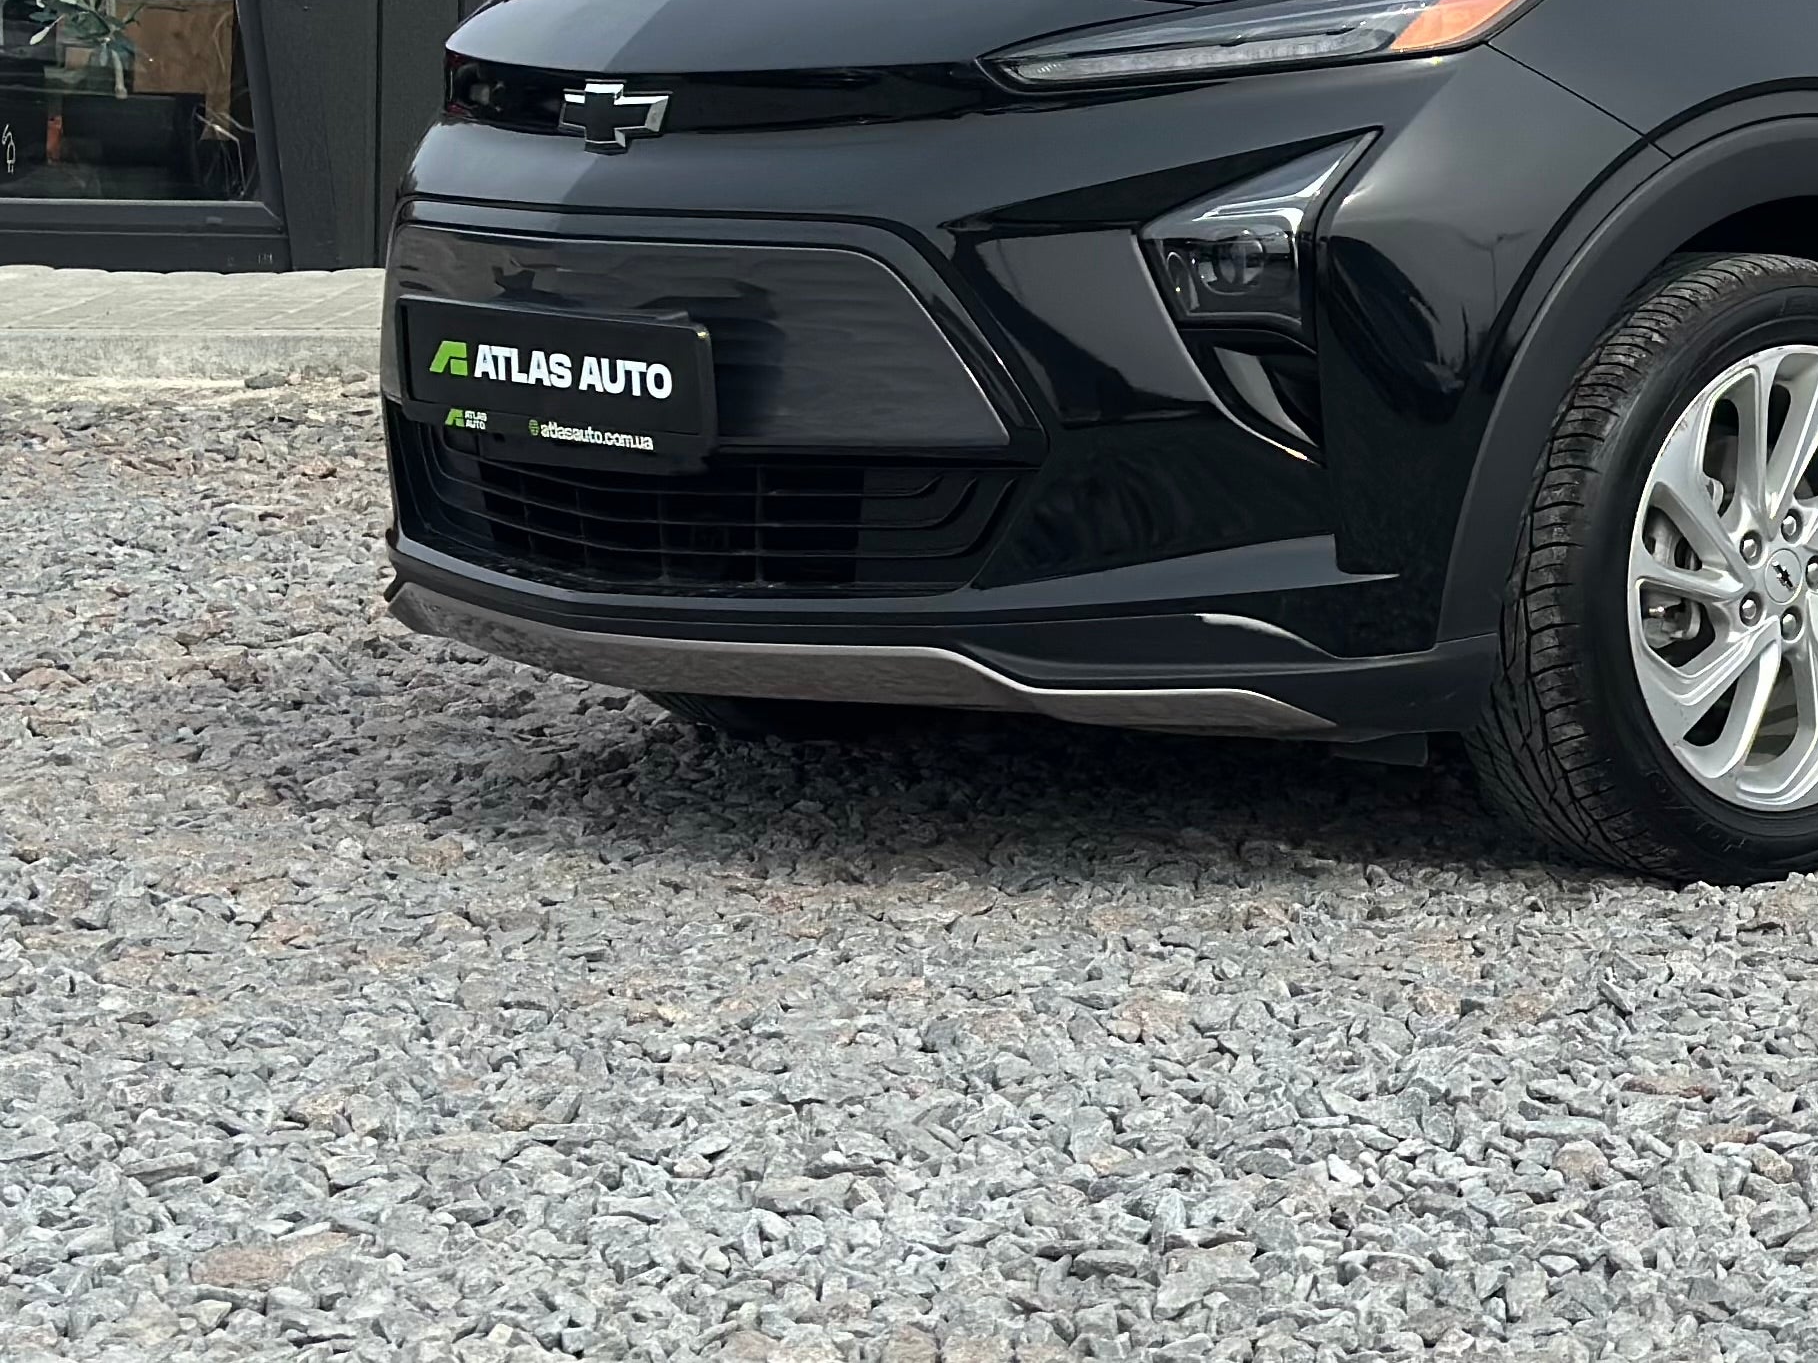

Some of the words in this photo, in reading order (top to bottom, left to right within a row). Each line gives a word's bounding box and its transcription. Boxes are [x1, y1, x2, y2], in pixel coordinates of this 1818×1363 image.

[473, 344, 573, 388] ATLAS
[578, 355, 673, 399] AUTO
[464, 419, 487, 430] AUTO
[540, 420, 654, 451] atlasauto.com.ua
